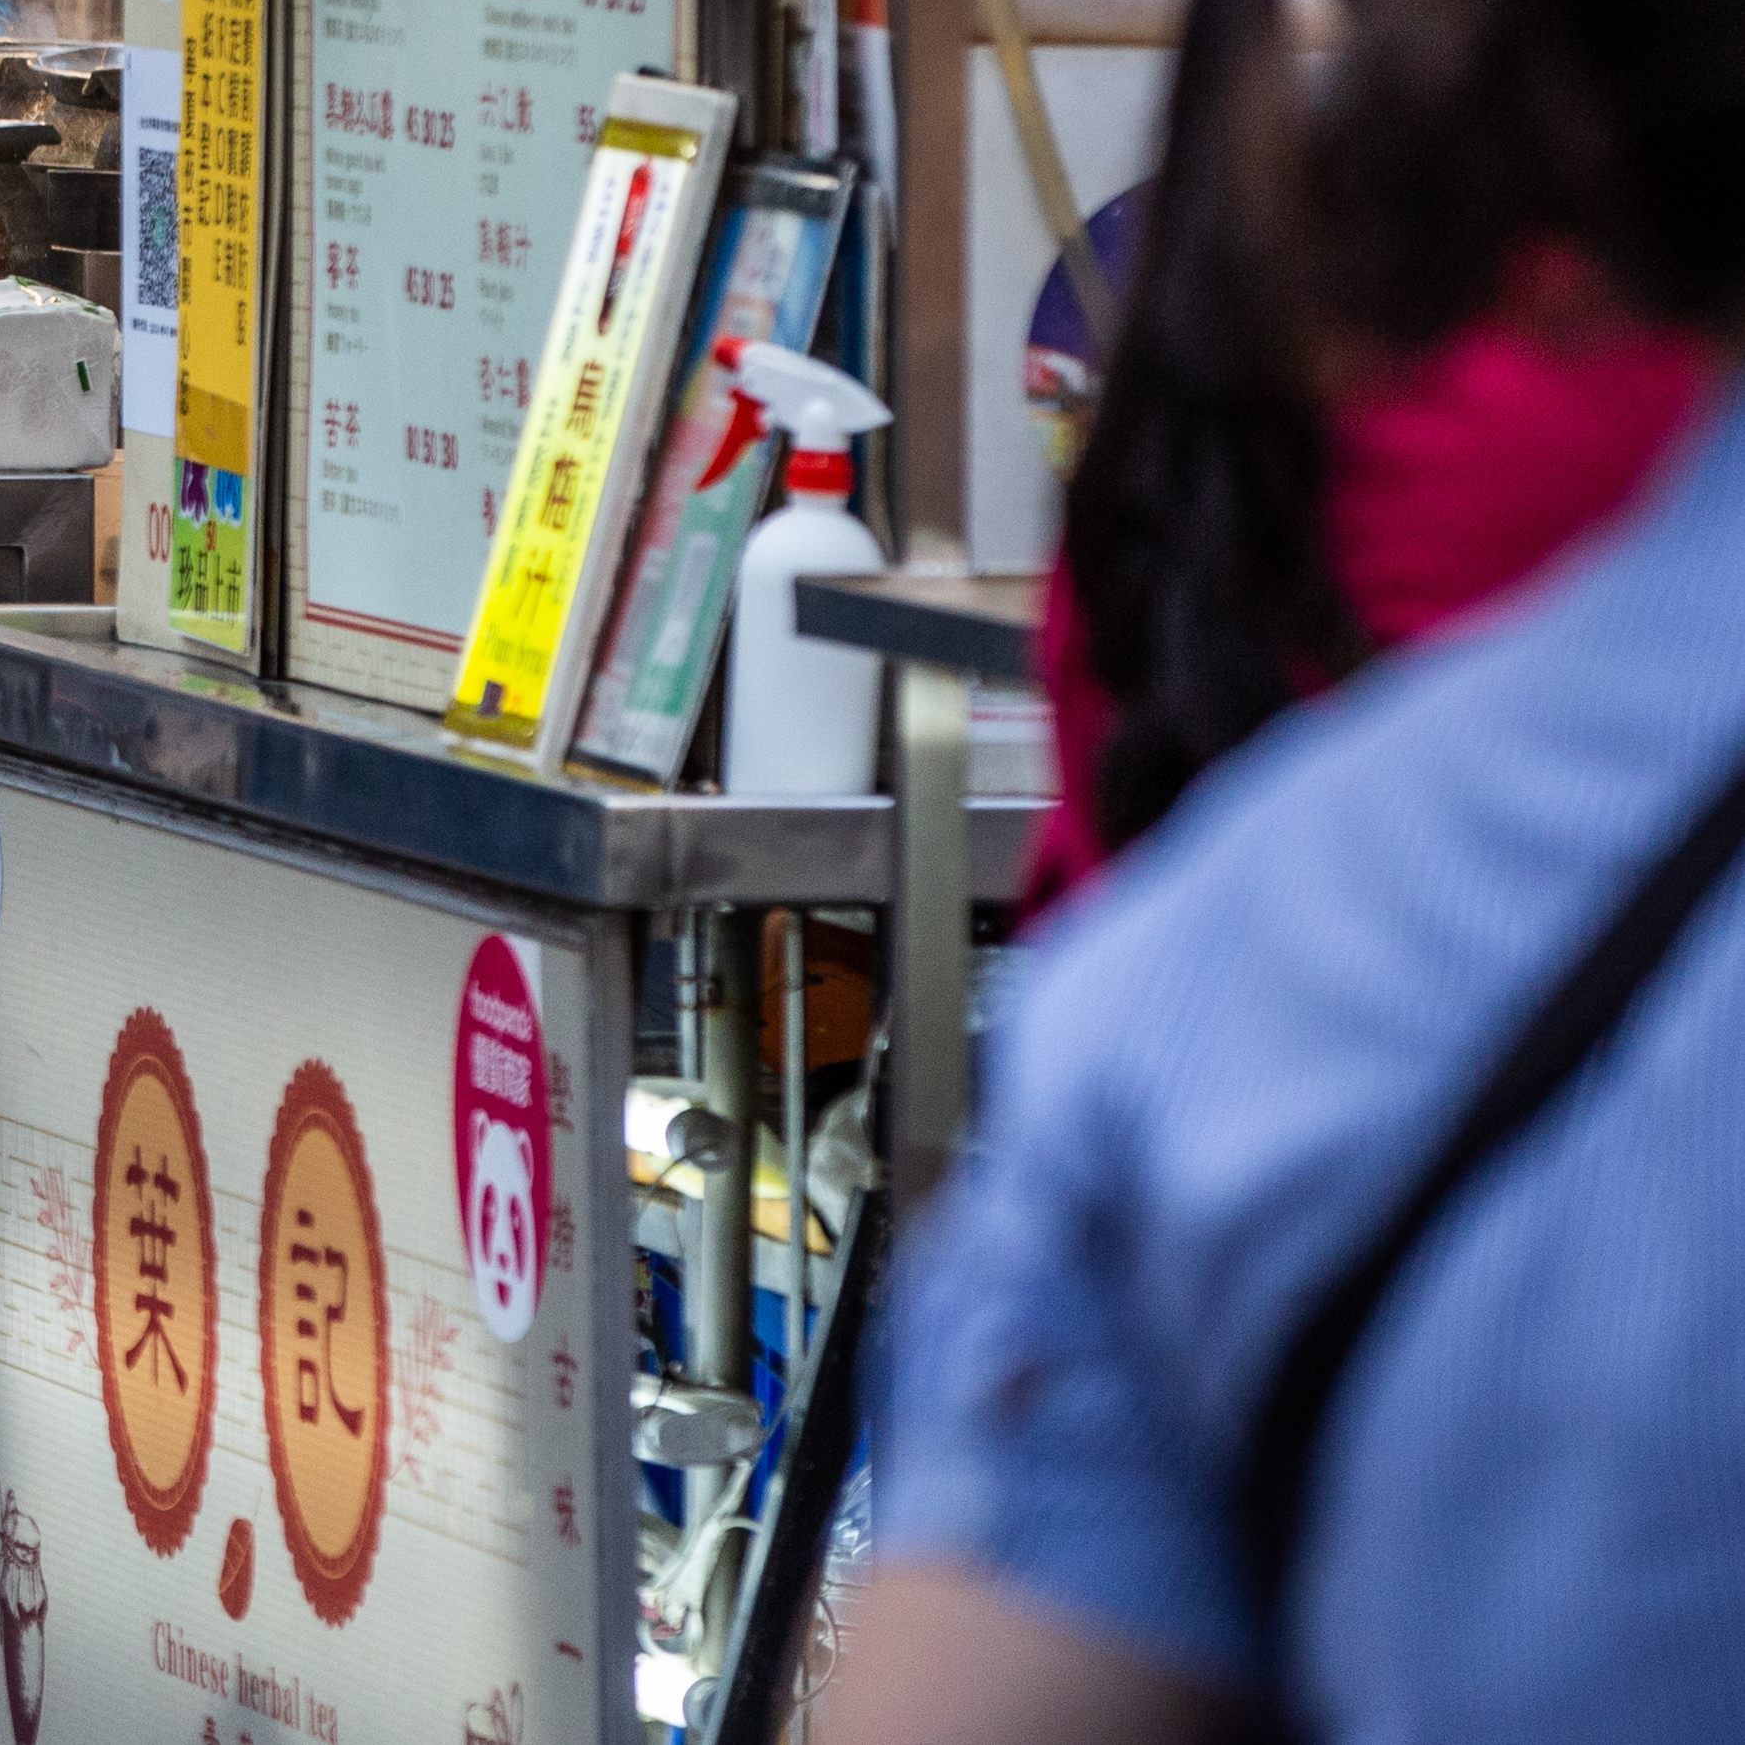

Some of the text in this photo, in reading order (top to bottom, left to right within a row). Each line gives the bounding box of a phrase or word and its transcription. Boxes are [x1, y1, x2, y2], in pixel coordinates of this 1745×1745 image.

[125, 1144, 365, 1440] 葉記
[151, 1619, 340, 1745] Chinese herbal tea
